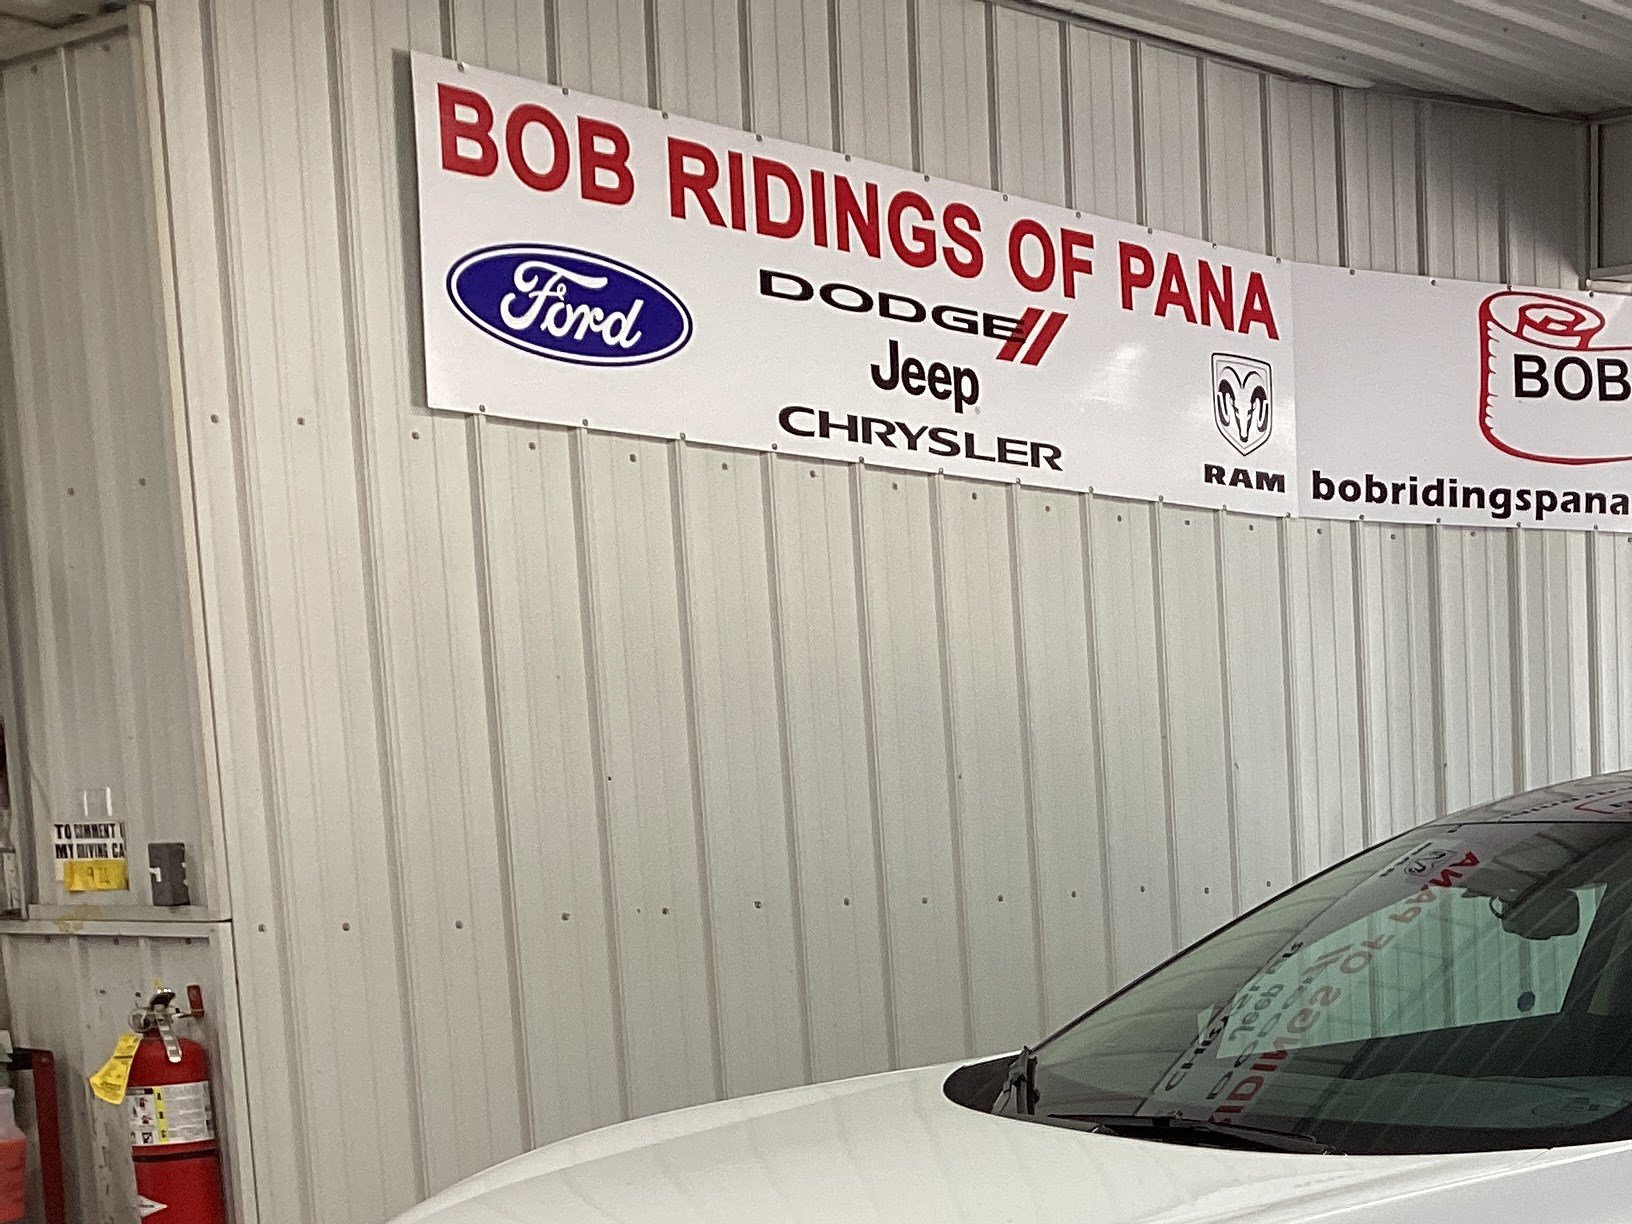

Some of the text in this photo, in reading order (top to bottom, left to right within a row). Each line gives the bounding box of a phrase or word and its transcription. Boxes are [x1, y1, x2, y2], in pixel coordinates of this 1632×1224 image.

[437, 82, 1280, 341] BOB RIDINGS OF PANA
[497, 260, 643, 349] Ford
[758, 269, 1027, 344] DODGE
[870, 339, 980, 414] Jeep
[1512, 353, 1632, 401] BOB
[777, 406, 1064, 472] CHRYSLER
[1203, 462, 1286, 494] RAM
[54, 823, 72, 840] TO
[54, 843, 74, 860] MY
